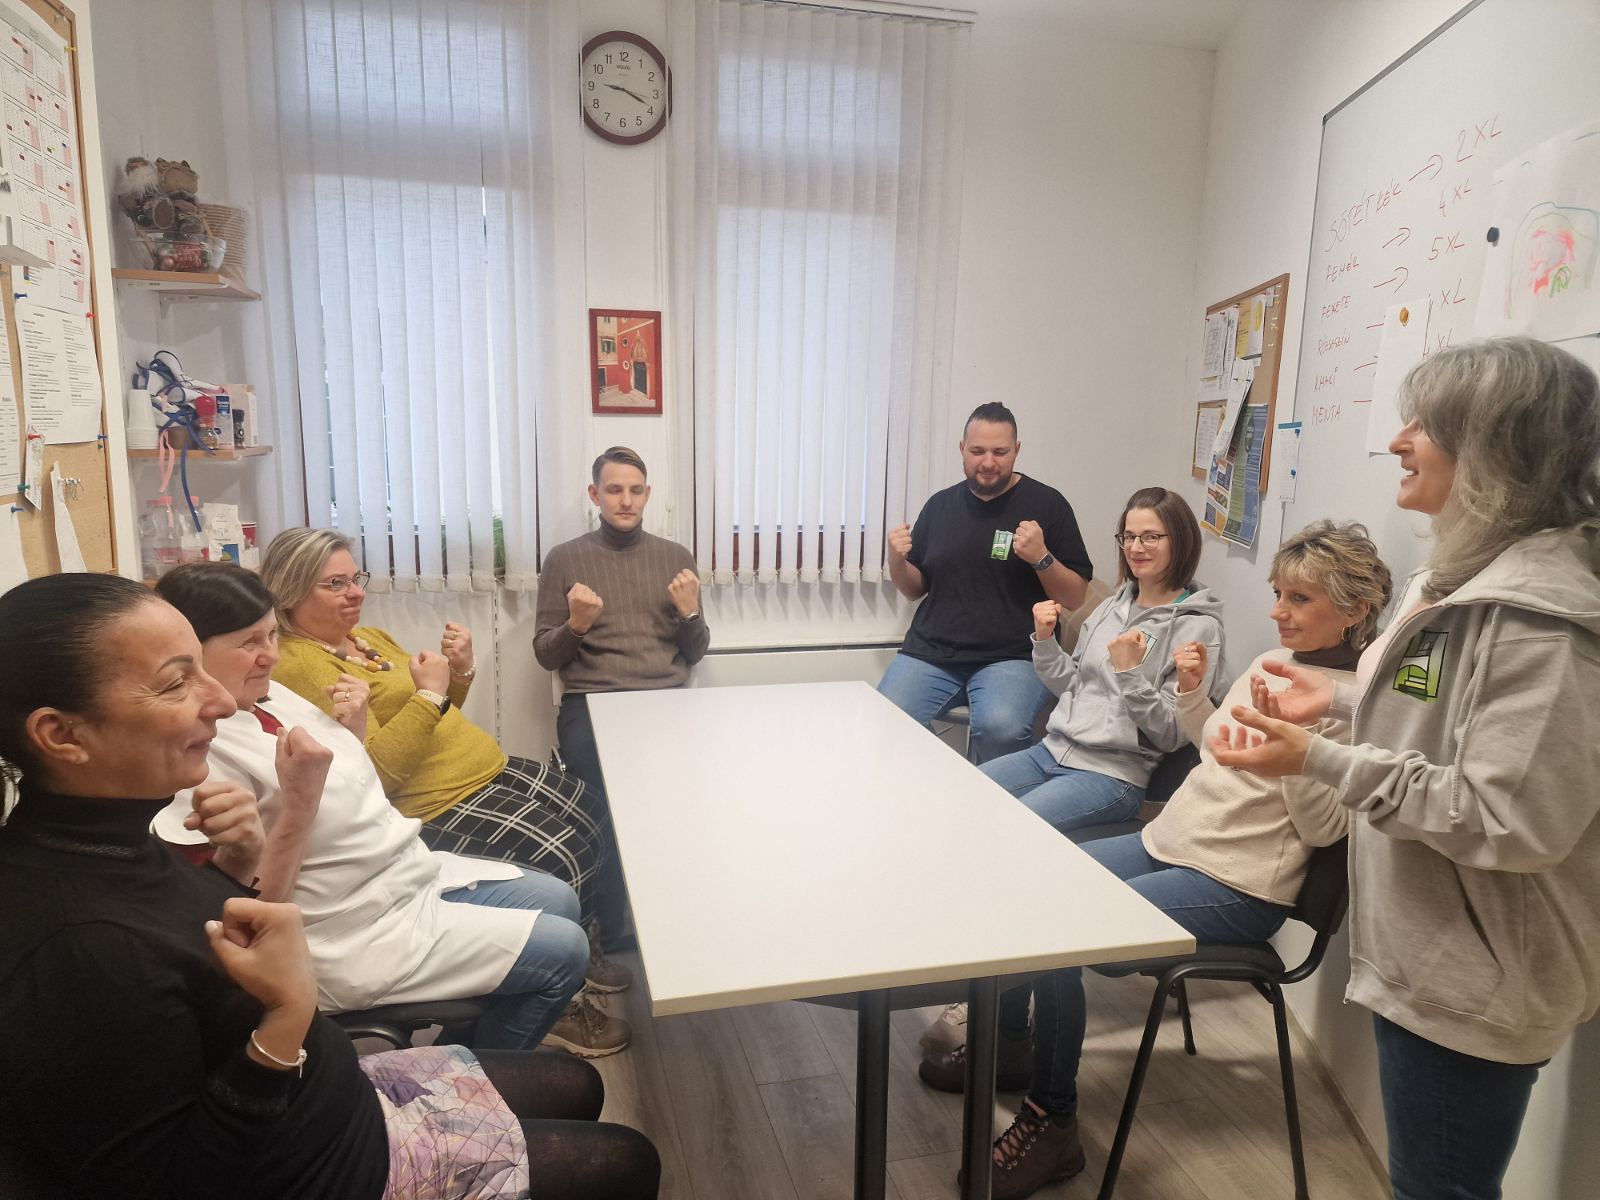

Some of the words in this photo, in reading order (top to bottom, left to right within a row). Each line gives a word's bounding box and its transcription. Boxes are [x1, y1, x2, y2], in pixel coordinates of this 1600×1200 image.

[605, 54, 612, 64] 11
[619, 51, 629, 62] 12
[638, 59, 643, 69] 1
[593, 64, 604, 75] 10
[648, 71, 655, 82] 2
[588, 81, 595, 91] 9
[652, 89, 659, 99] 3
[592, 98, 600, 109] 8
[647, 106, 653, 116] 4
[604, 112, 611, 122] 7
[635, 116, 643, 126] 5
[620, 117, 627, 128] 6
